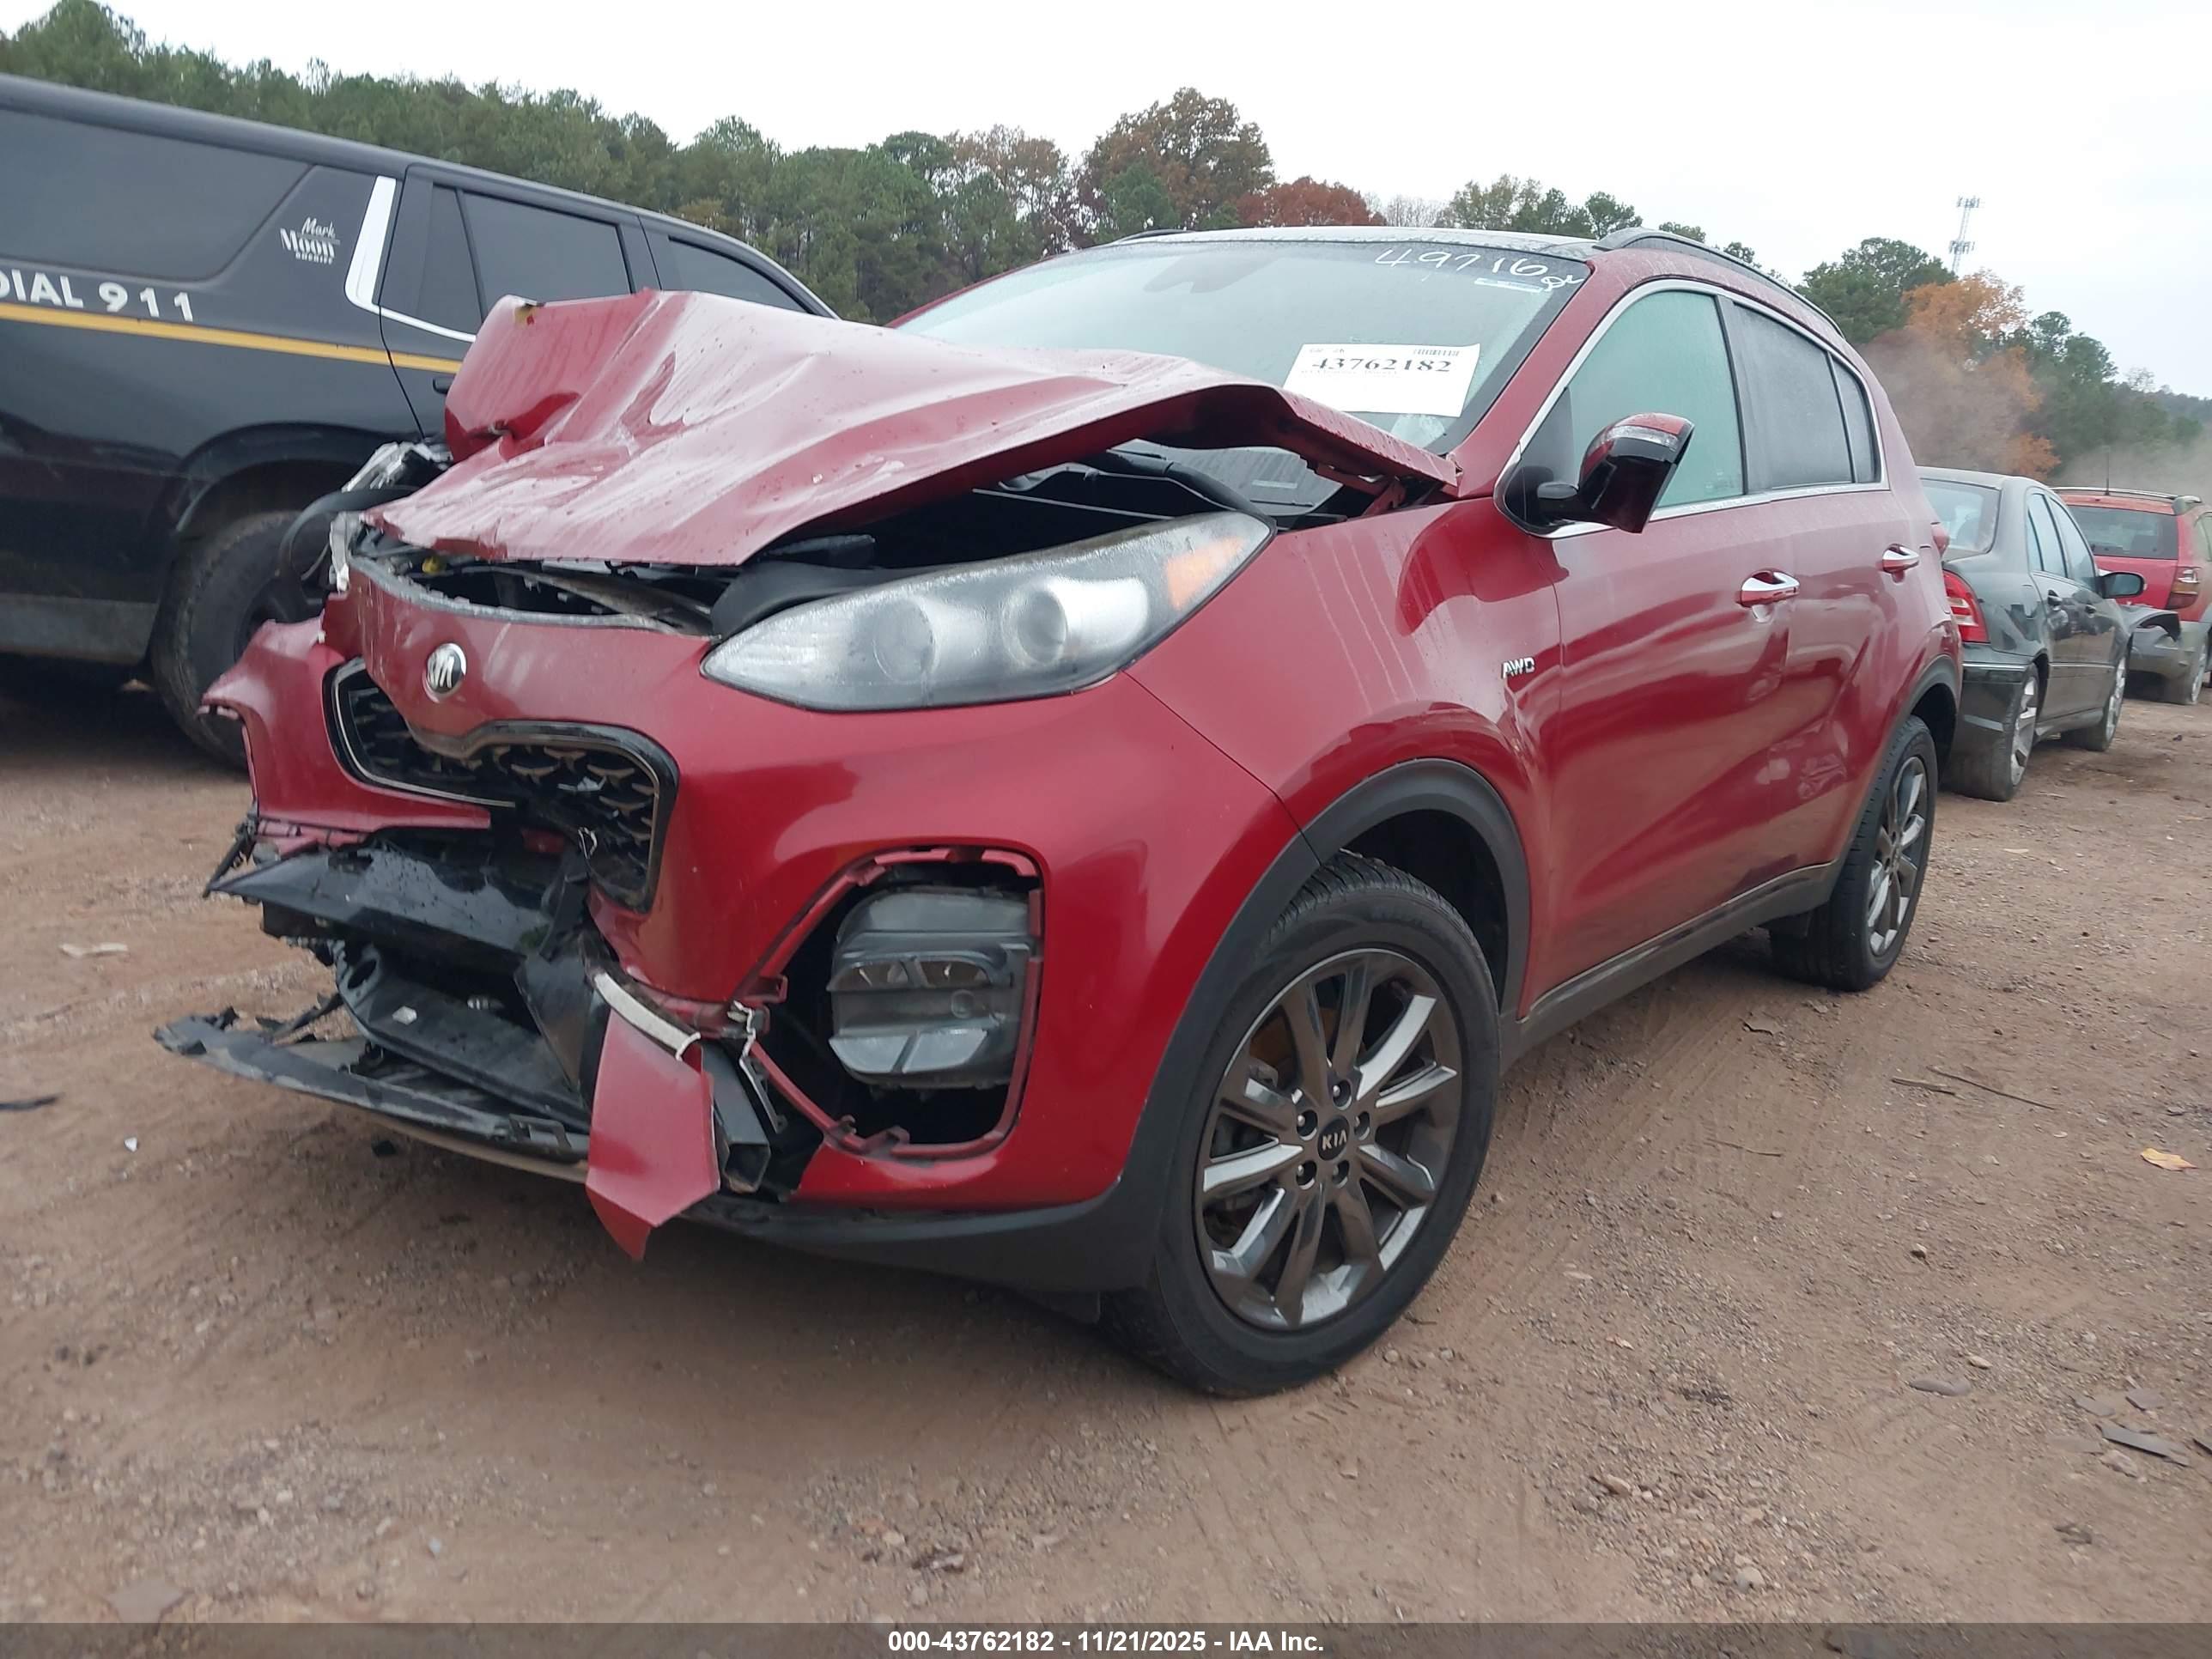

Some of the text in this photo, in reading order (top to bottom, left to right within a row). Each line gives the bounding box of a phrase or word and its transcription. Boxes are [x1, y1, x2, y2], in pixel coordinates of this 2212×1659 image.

[301, 216, 336, 240] Mark
[280, 228, 335, 258] Moon
[99, 282, 193, 322] 911
[1311, 357, 1452, 373] 43762182
[1501, 657, 1535, 679] AWD
[1322, 1129, 1347, 1151] KIA
